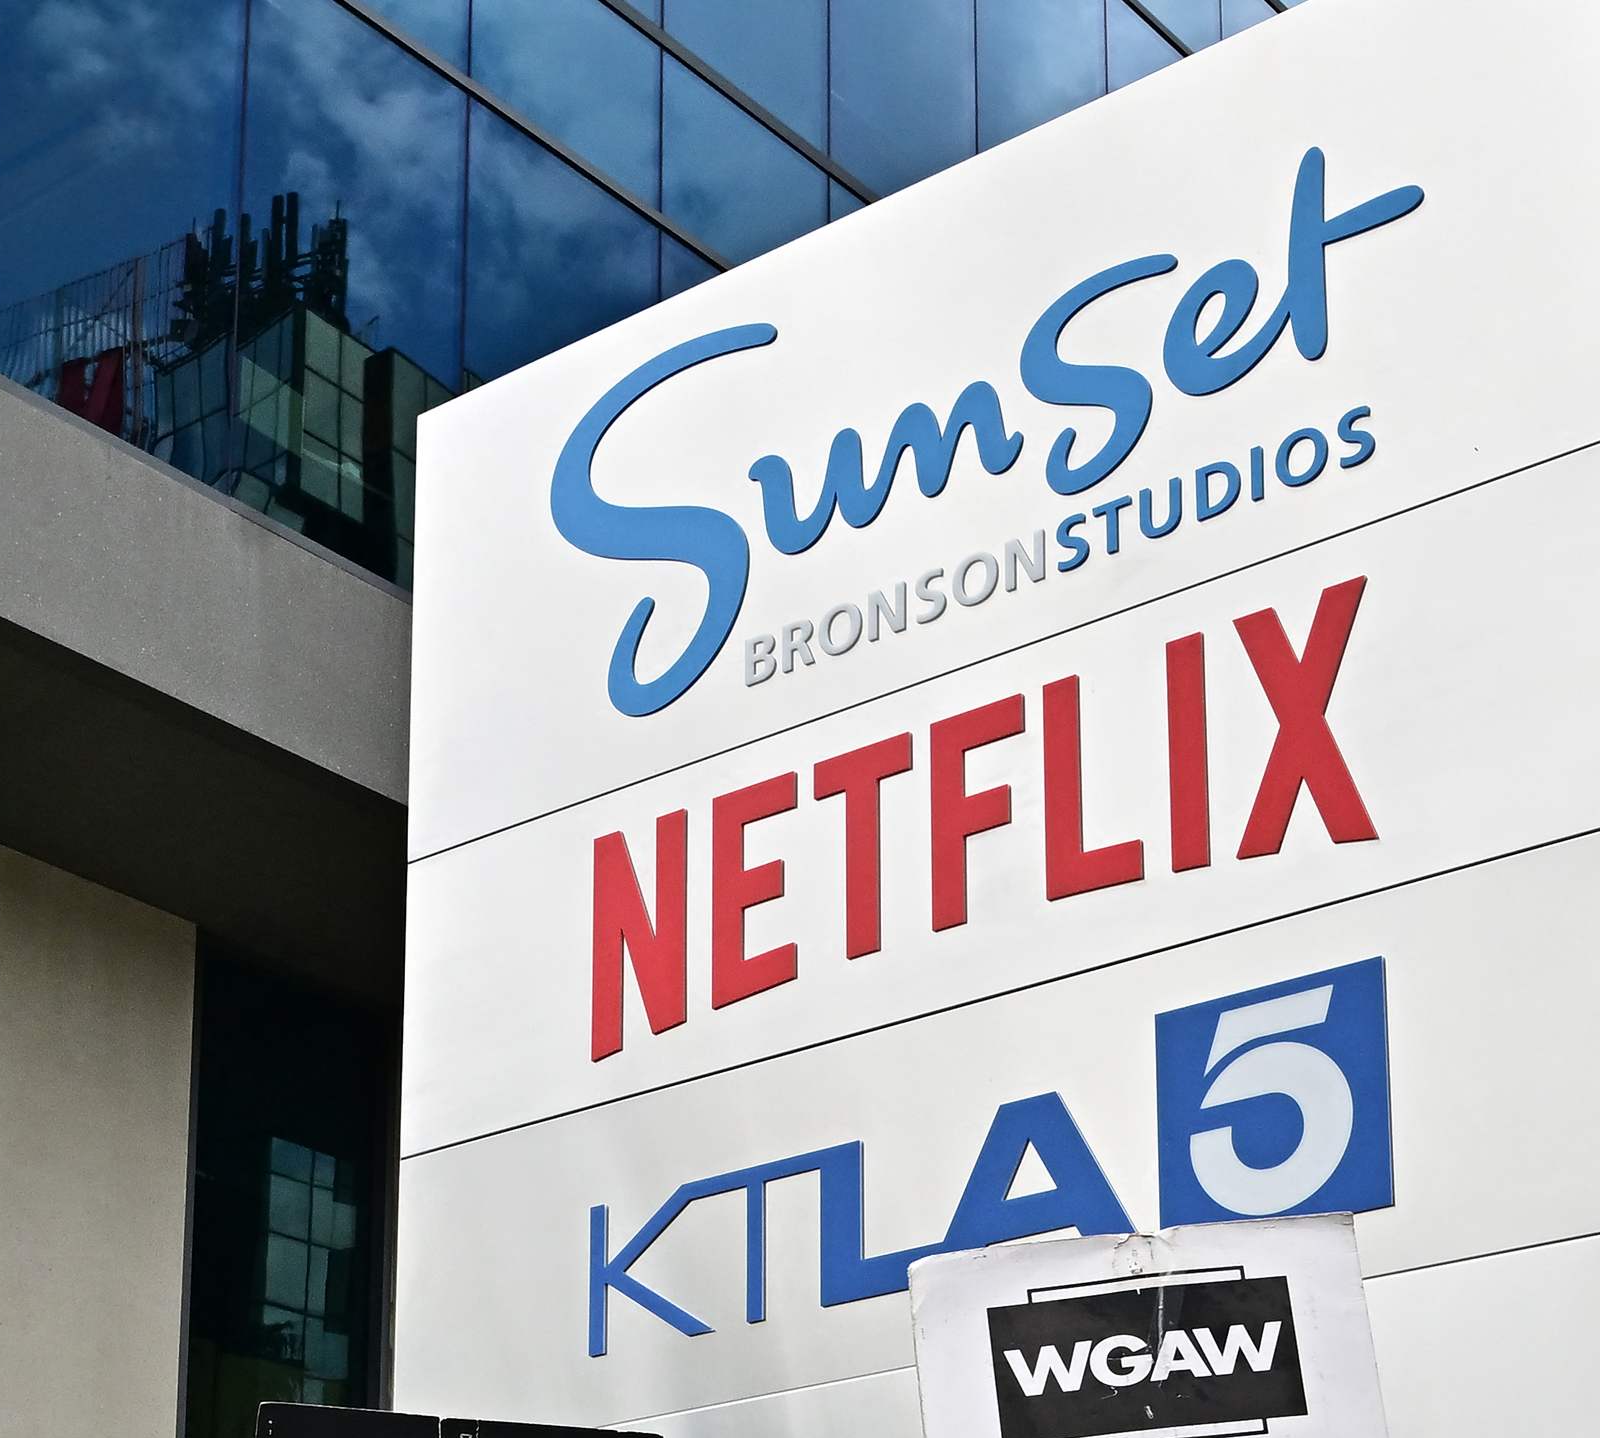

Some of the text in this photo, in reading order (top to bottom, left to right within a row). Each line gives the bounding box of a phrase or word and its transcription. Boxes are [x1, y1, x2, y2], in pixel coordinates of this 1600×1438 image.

[590, 574, 1379, 1063] NETFLIX
[588, 983, 1356, 1358] KTLA 5
[1004, 1320, 1282, 1397] WGAW
